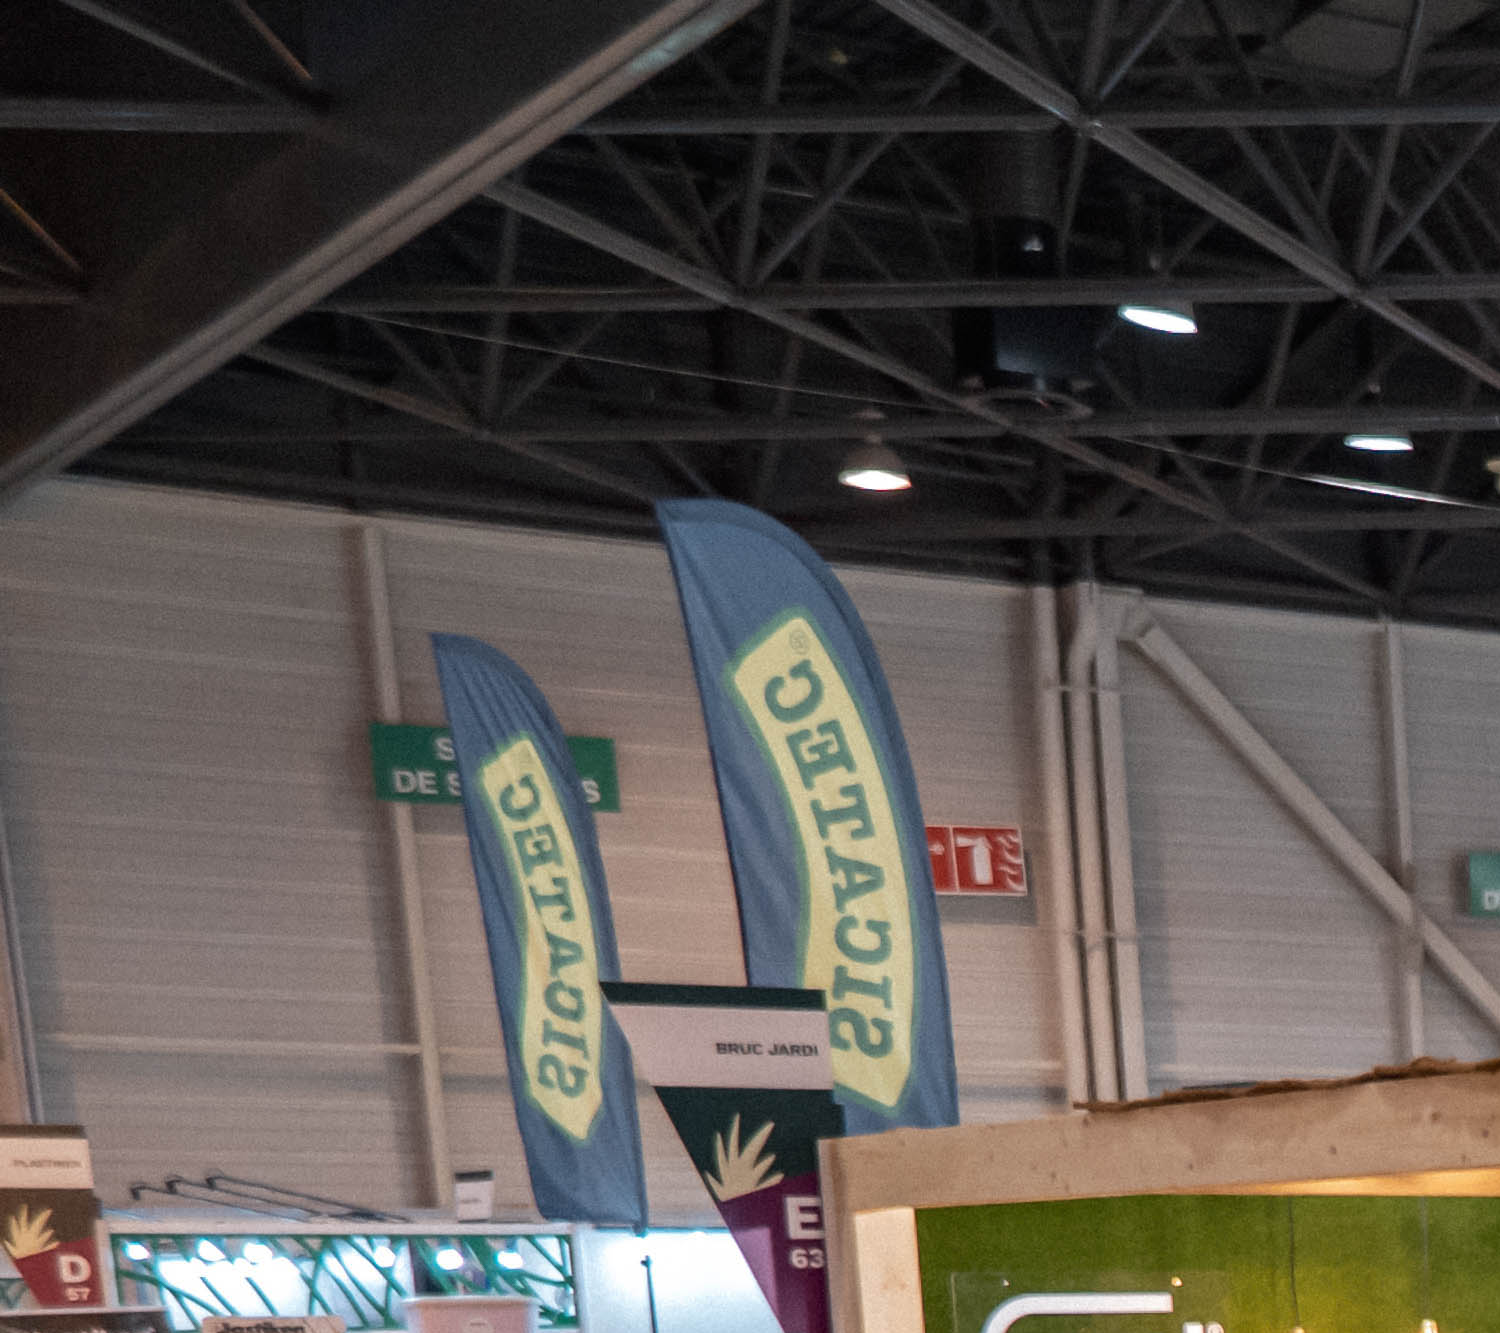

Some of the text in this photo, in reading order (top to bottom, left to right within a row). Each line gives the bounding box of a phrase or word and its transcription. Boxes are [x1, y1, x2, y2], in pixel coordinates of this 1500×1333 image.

[392, 769, 439, 796] DE
[715, 1041, 819, 1057] BRUC JARDI
[784, 1196, 825, 1240] E
[58, 1254, 92, 1284] D
[790, 1248, 825, 1270] 63
